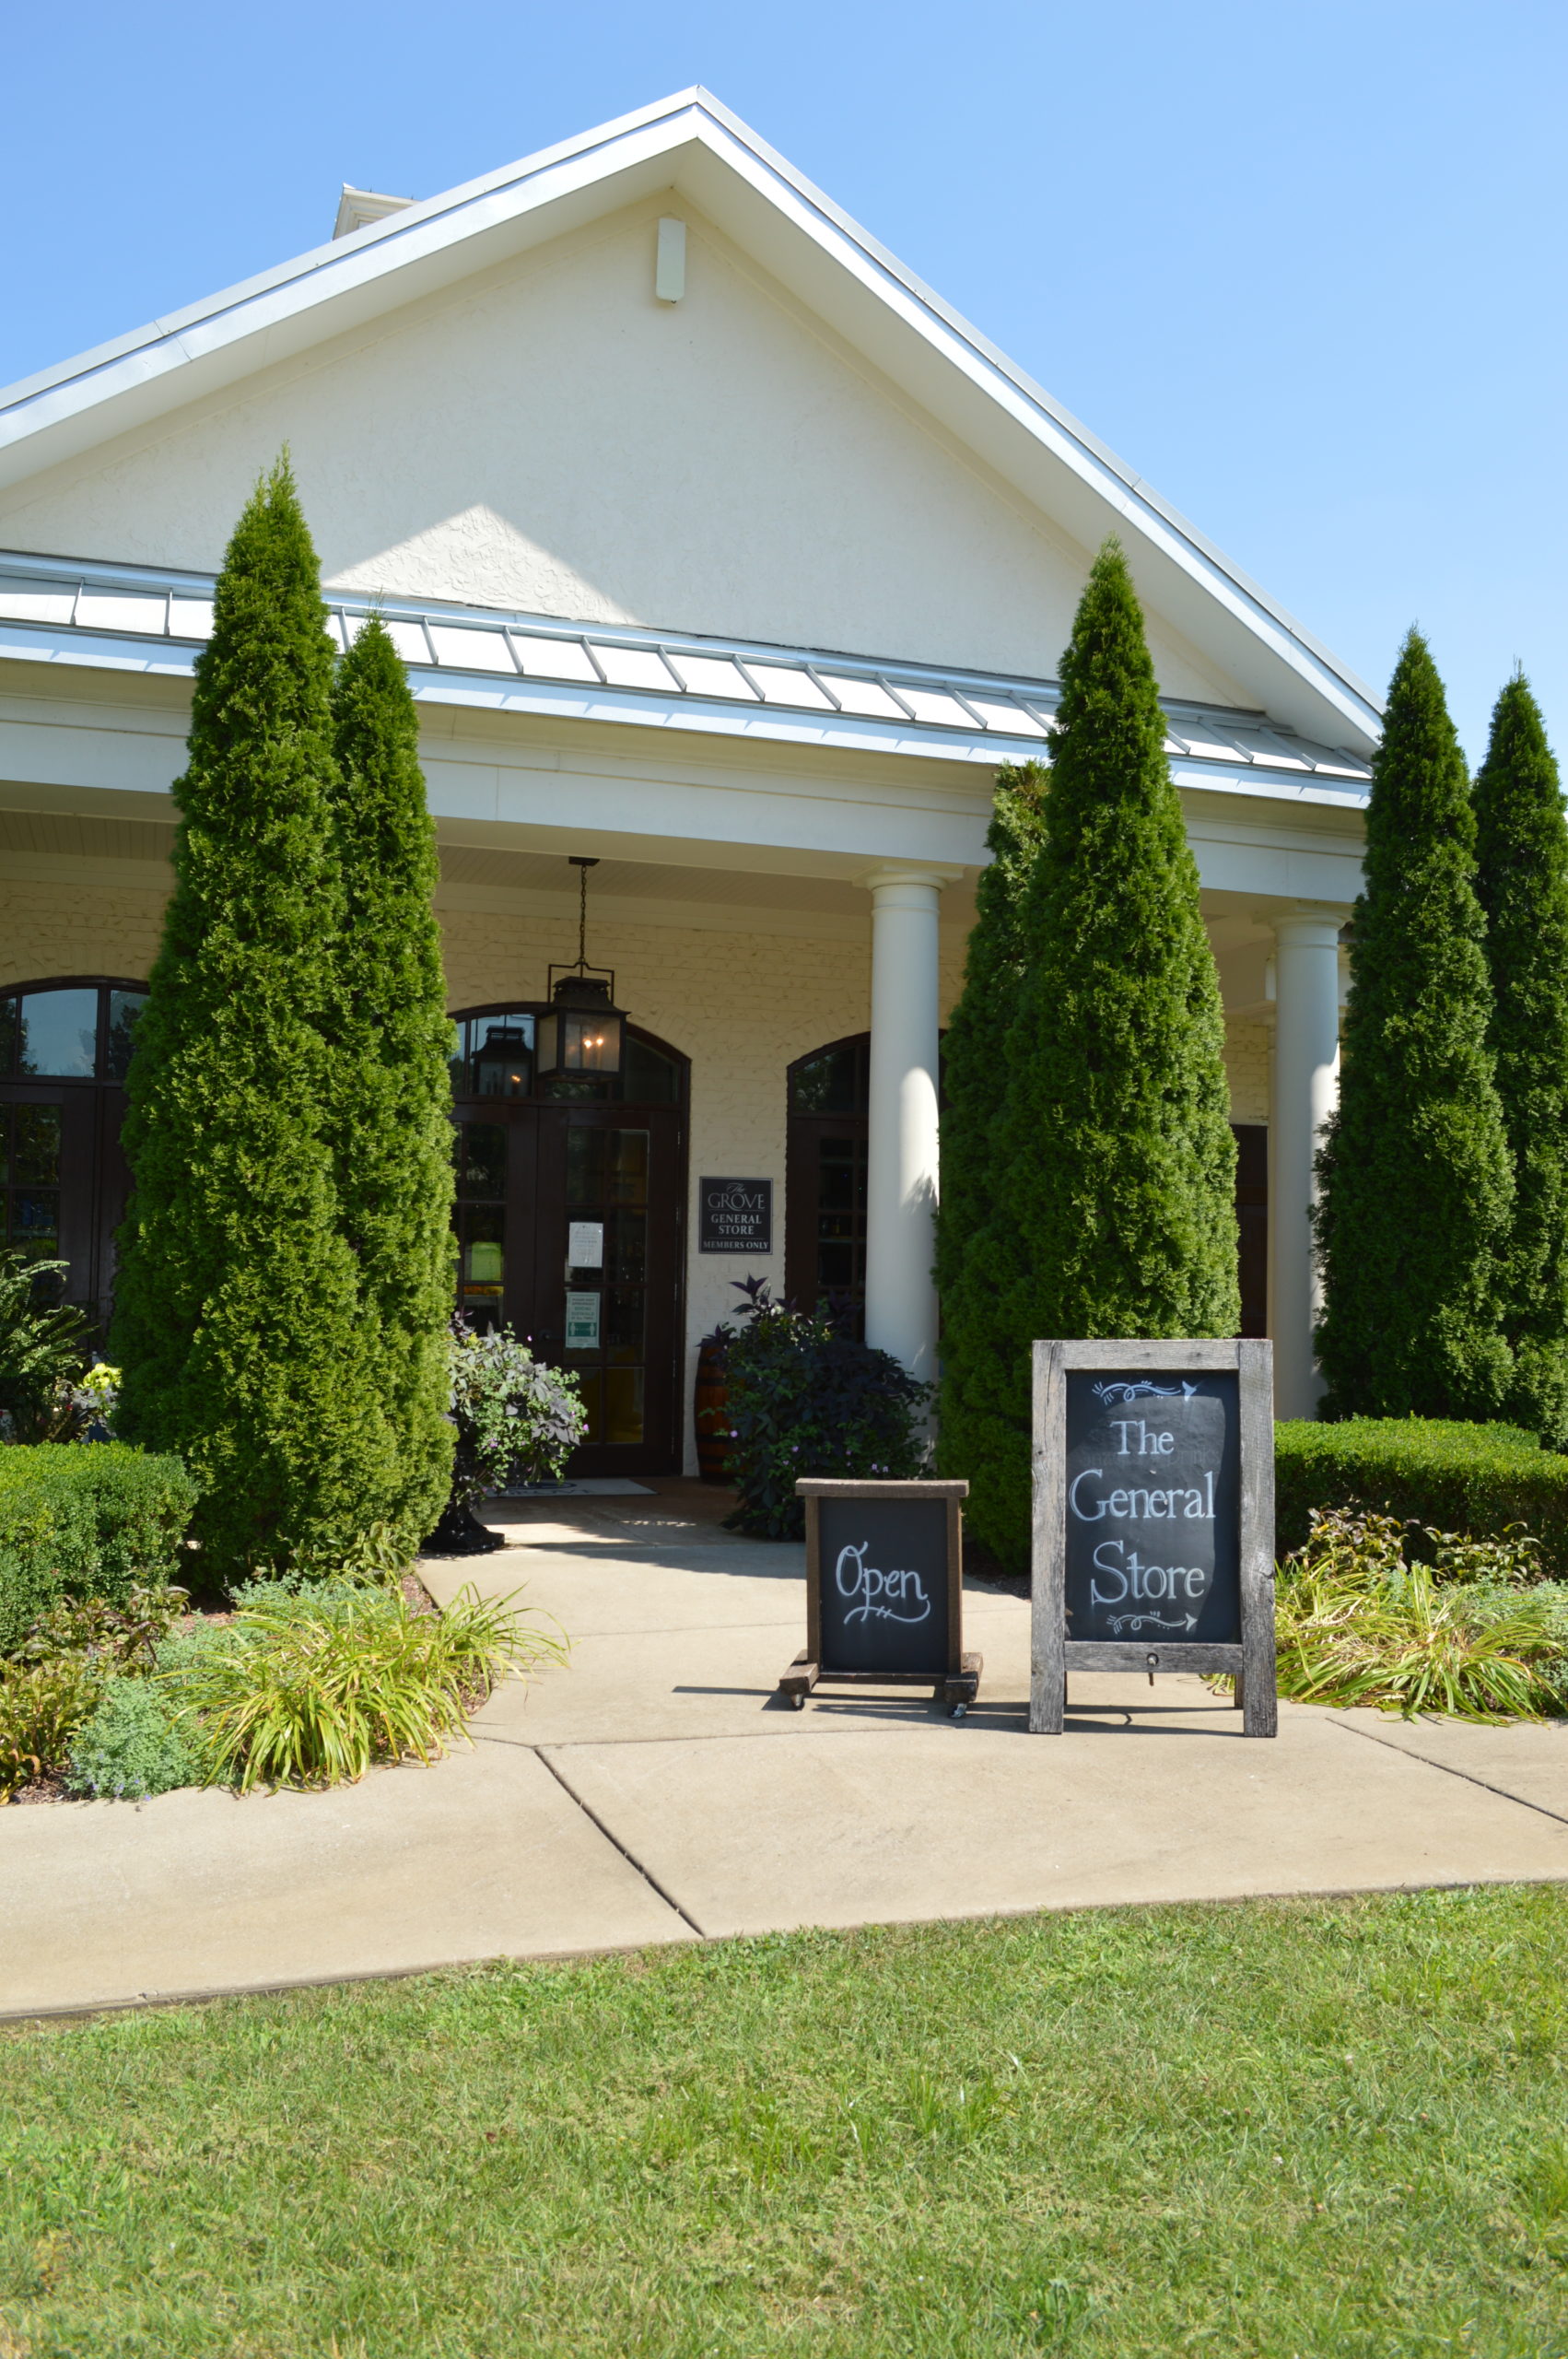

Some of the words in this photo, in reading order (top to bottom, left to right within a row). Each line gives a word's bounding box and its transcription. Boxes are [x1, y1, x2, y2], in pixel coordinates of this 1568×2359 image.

[726, 1182, 745, 1193] The
[708, 1192, 766, 1211] GROVE
[711, 1214, 762, 1224] GENERAL
[719, 1225, 755, 1235] STORE
[703, 1240, 744, 1249] MEMBERS
[746, 1241, 769, 1250] ONLY
[1109, 1419, 1175, 1456] The
[1069, 1469, 1217, 1521] General
[836, 1541, 929, 1622] Open
[1090, 1540, 1205, 1606] Store
